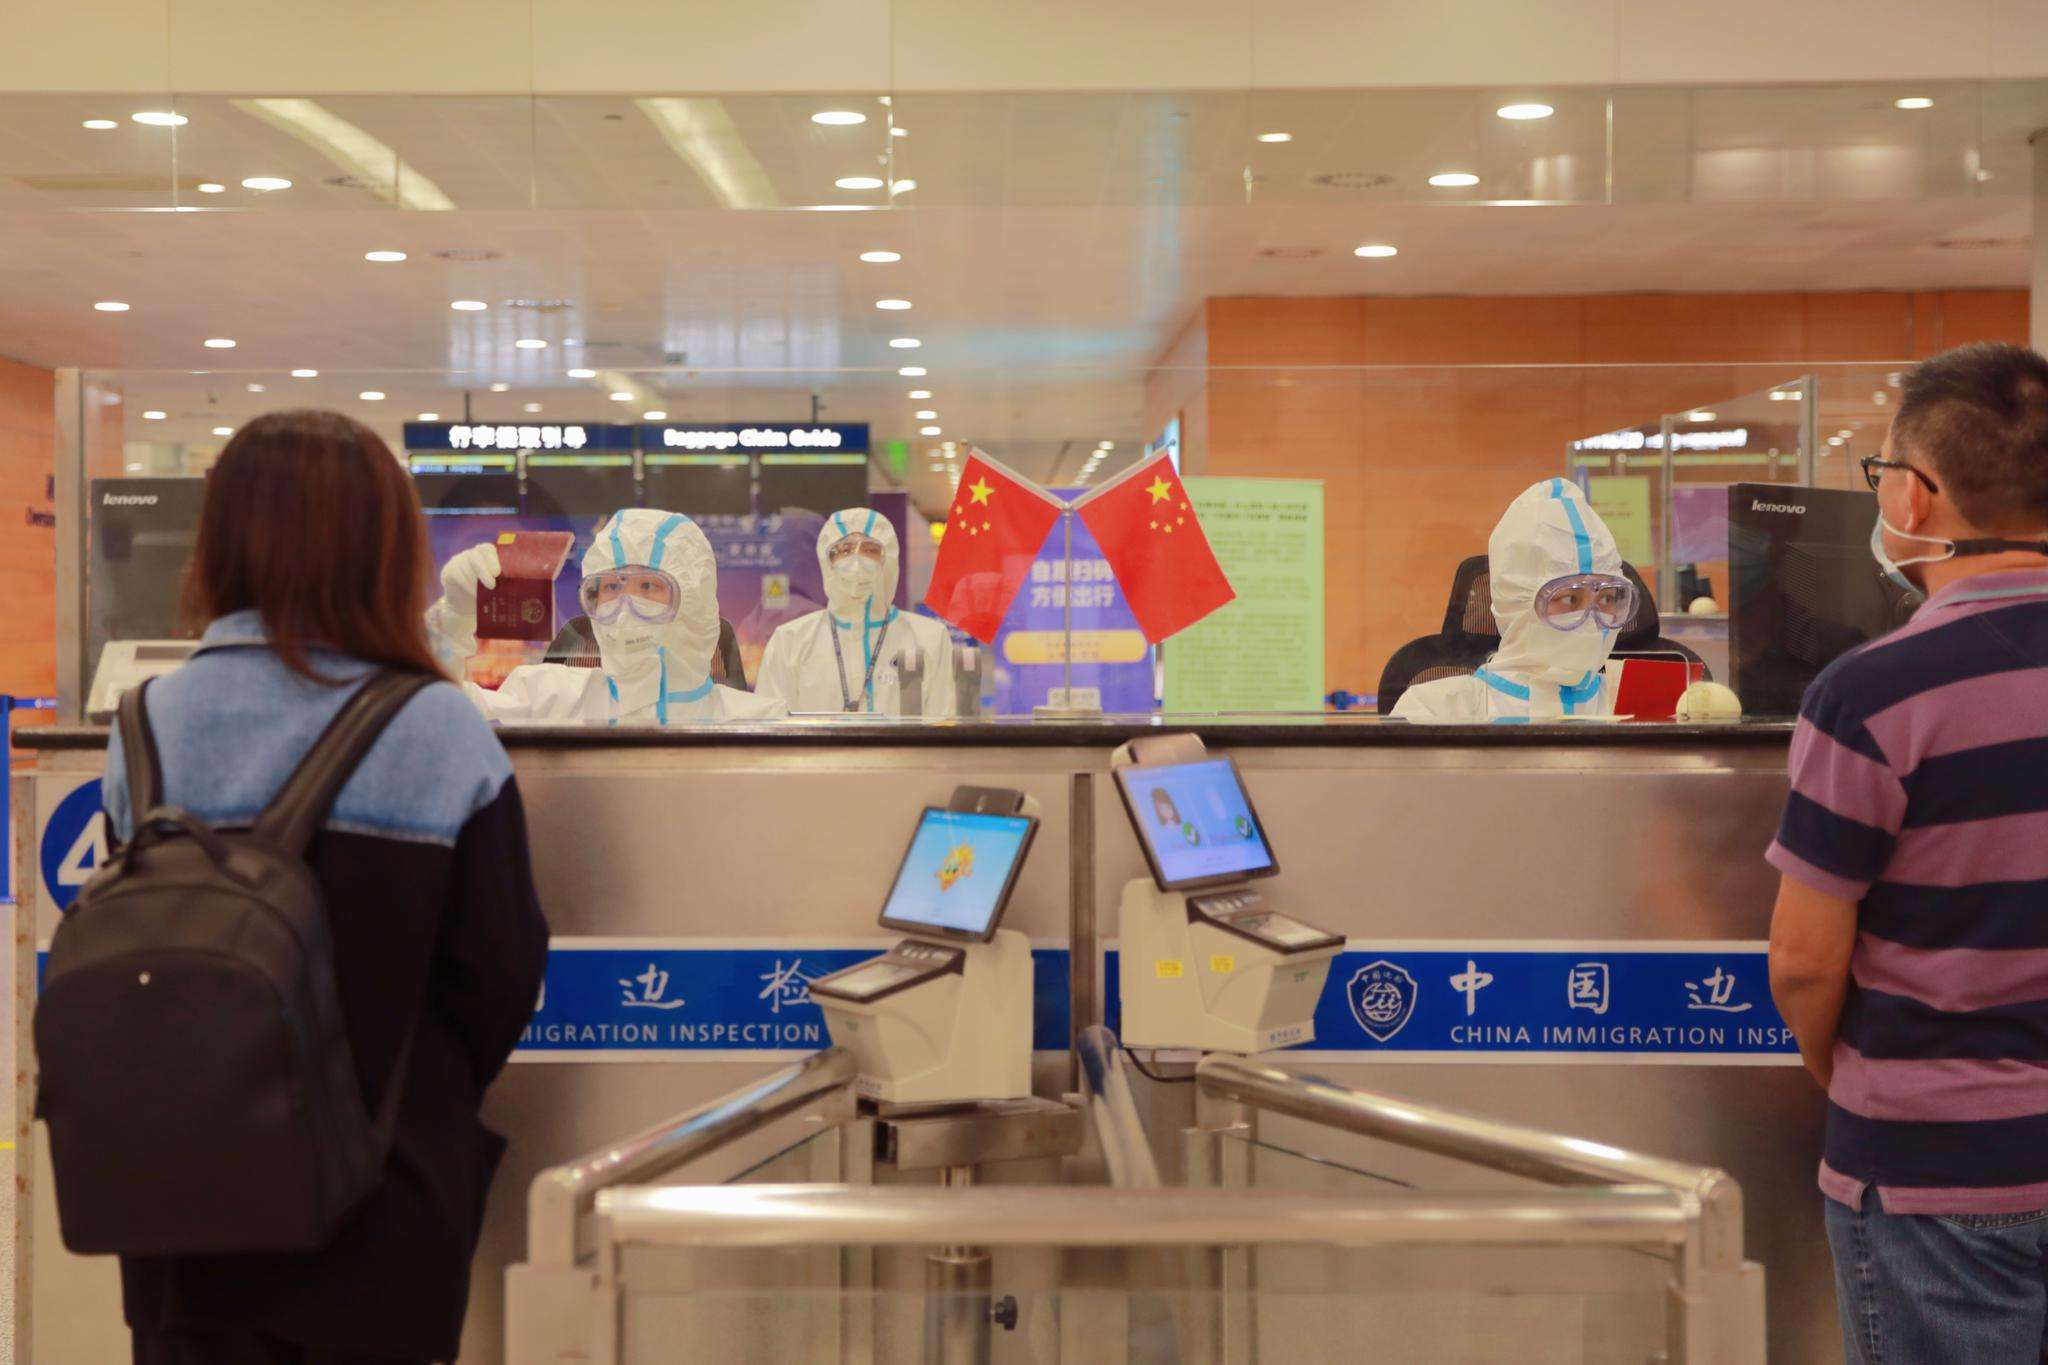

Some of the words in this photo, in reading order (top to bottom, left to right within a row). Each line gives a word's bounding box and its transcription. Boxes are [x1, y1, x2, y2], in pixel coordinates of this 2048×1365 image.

[103, 493, 158, 505] lenovo
[1752, 499, 1807, 515] lenovo
[57, 811, 110, 886] 4
[671, 1024, 820, 1042] INSPECTION
[1450, 1026, 1531, 1043] CHINA
[1543, 1026, 1725, 1044] IMMIGRATION
